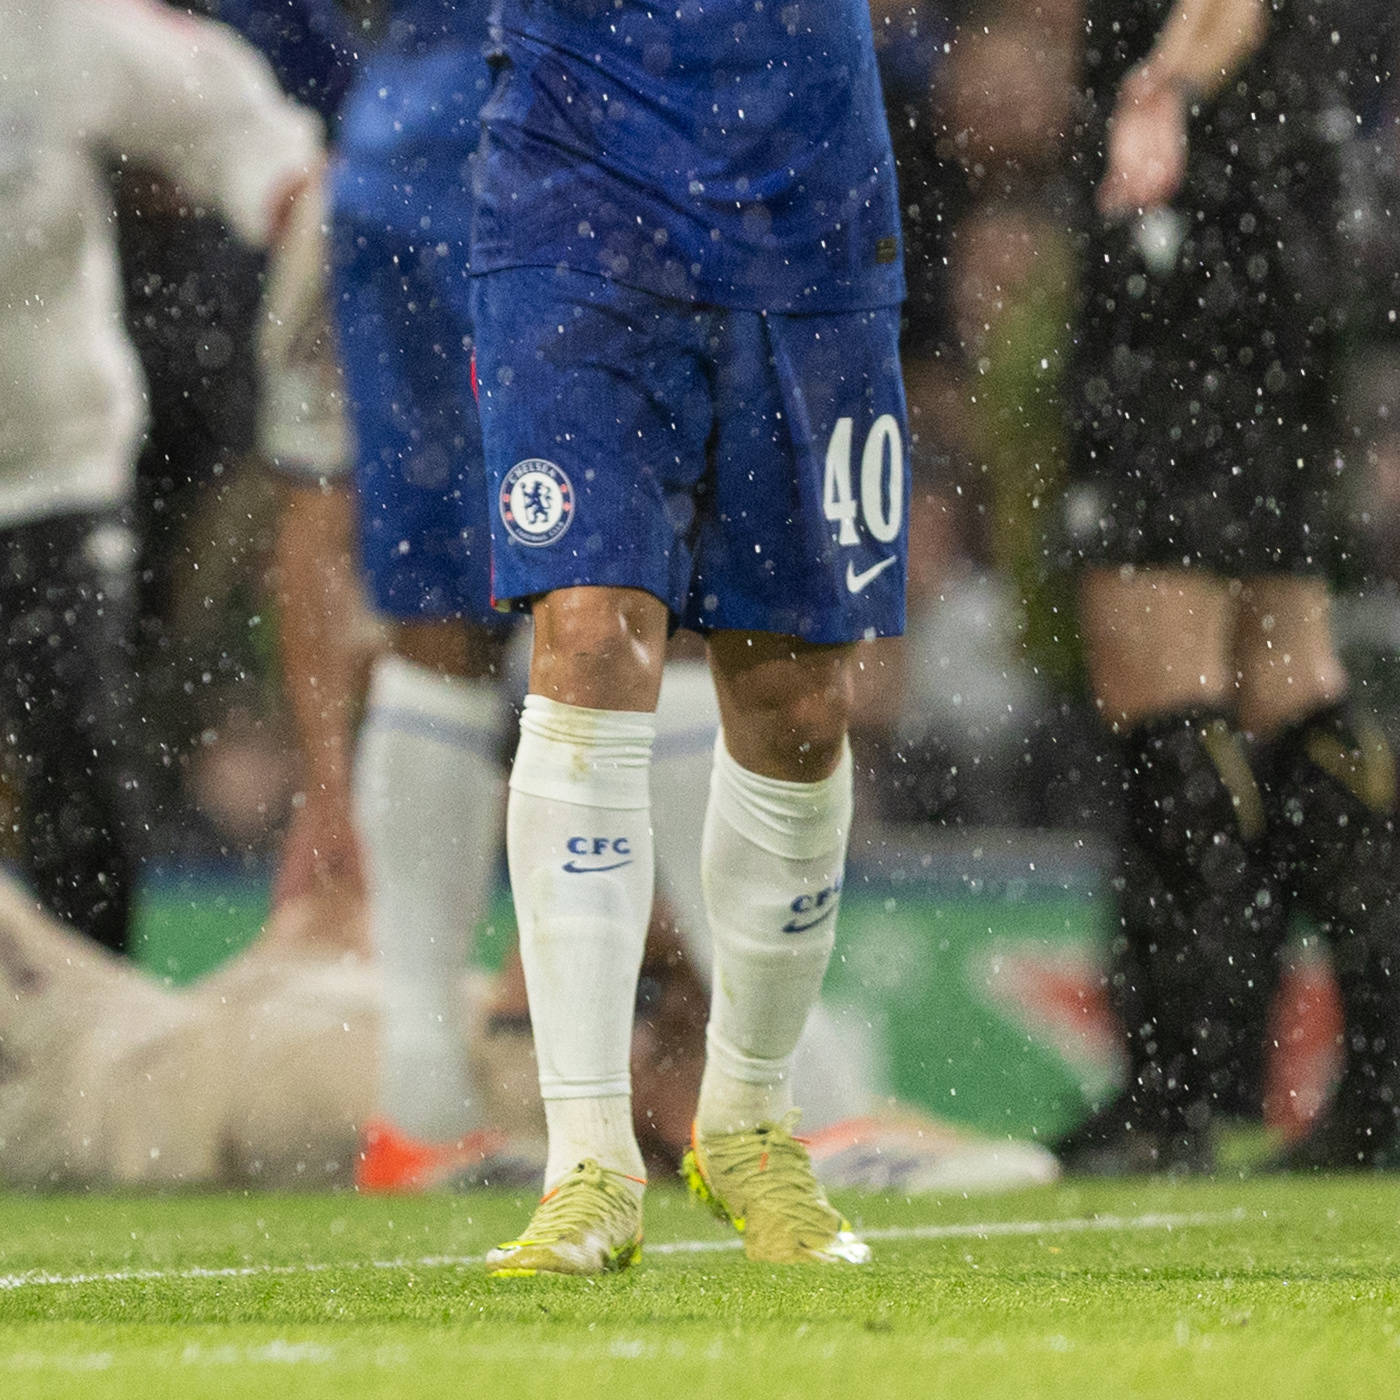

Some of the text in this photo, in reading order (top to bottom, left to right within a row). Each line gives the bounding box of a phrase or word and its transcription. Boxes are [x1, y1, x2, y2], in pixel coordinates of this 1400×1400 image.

[508, 462, 557, 484] CHELSEA
[823, 413, 904, 546] 40
[566, 836, 630, 855] CFC
